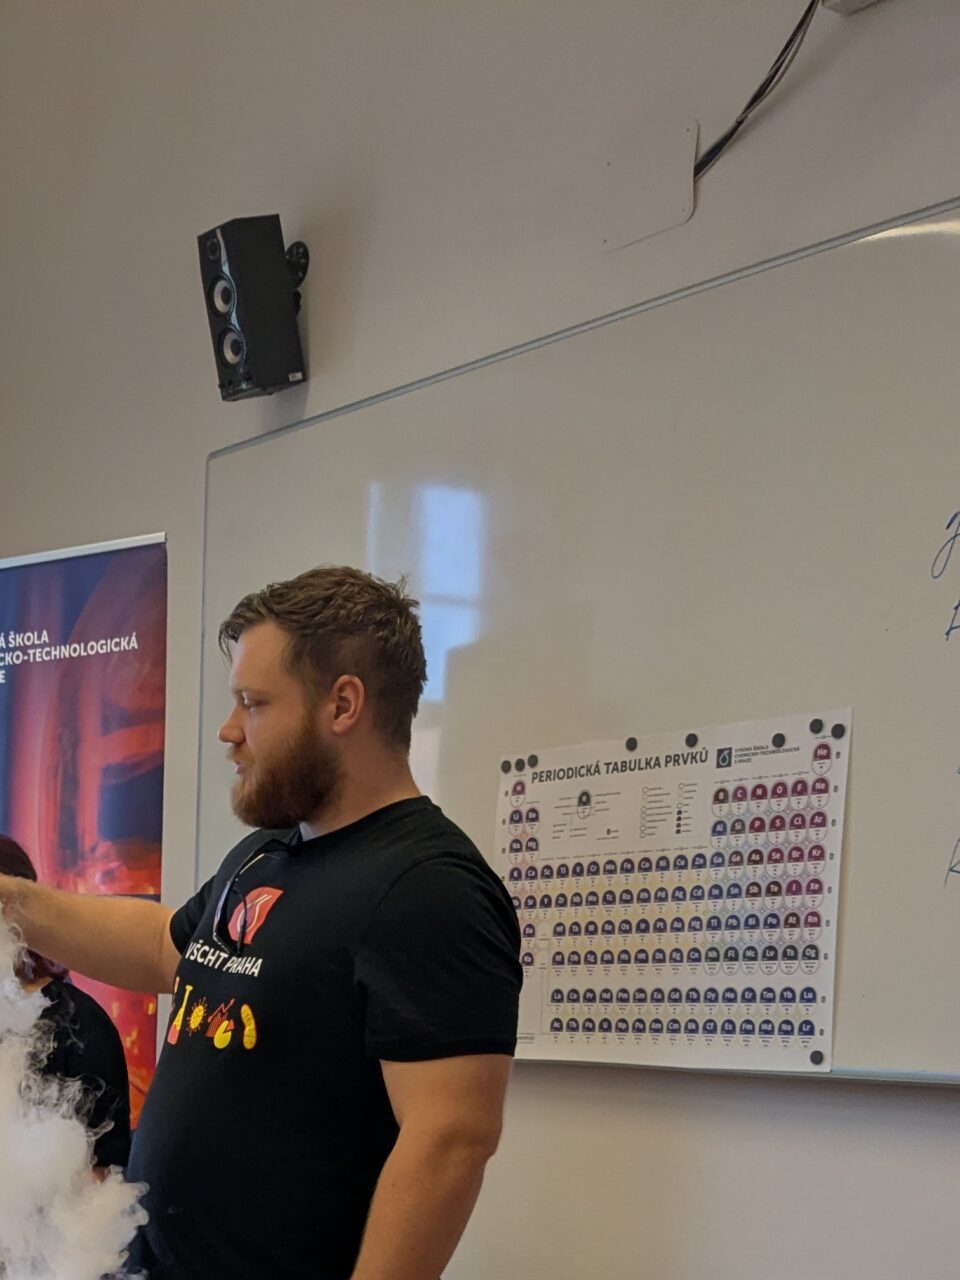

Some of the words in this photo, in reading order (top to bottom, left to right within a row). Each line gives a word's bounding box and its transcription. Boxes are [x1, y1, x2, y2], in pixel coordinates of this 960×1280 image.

[8, 630, 49, 648] ŠKOLA
[531, 760, 601, 784] PERIODICKÁ
[604, 756, 661, 775] TABULKA
[664, 747, 709, 768] PRVKŮ
[185, 939, 229, 969] VŠCHT
[222, 956, 263, 977] PRAHA
